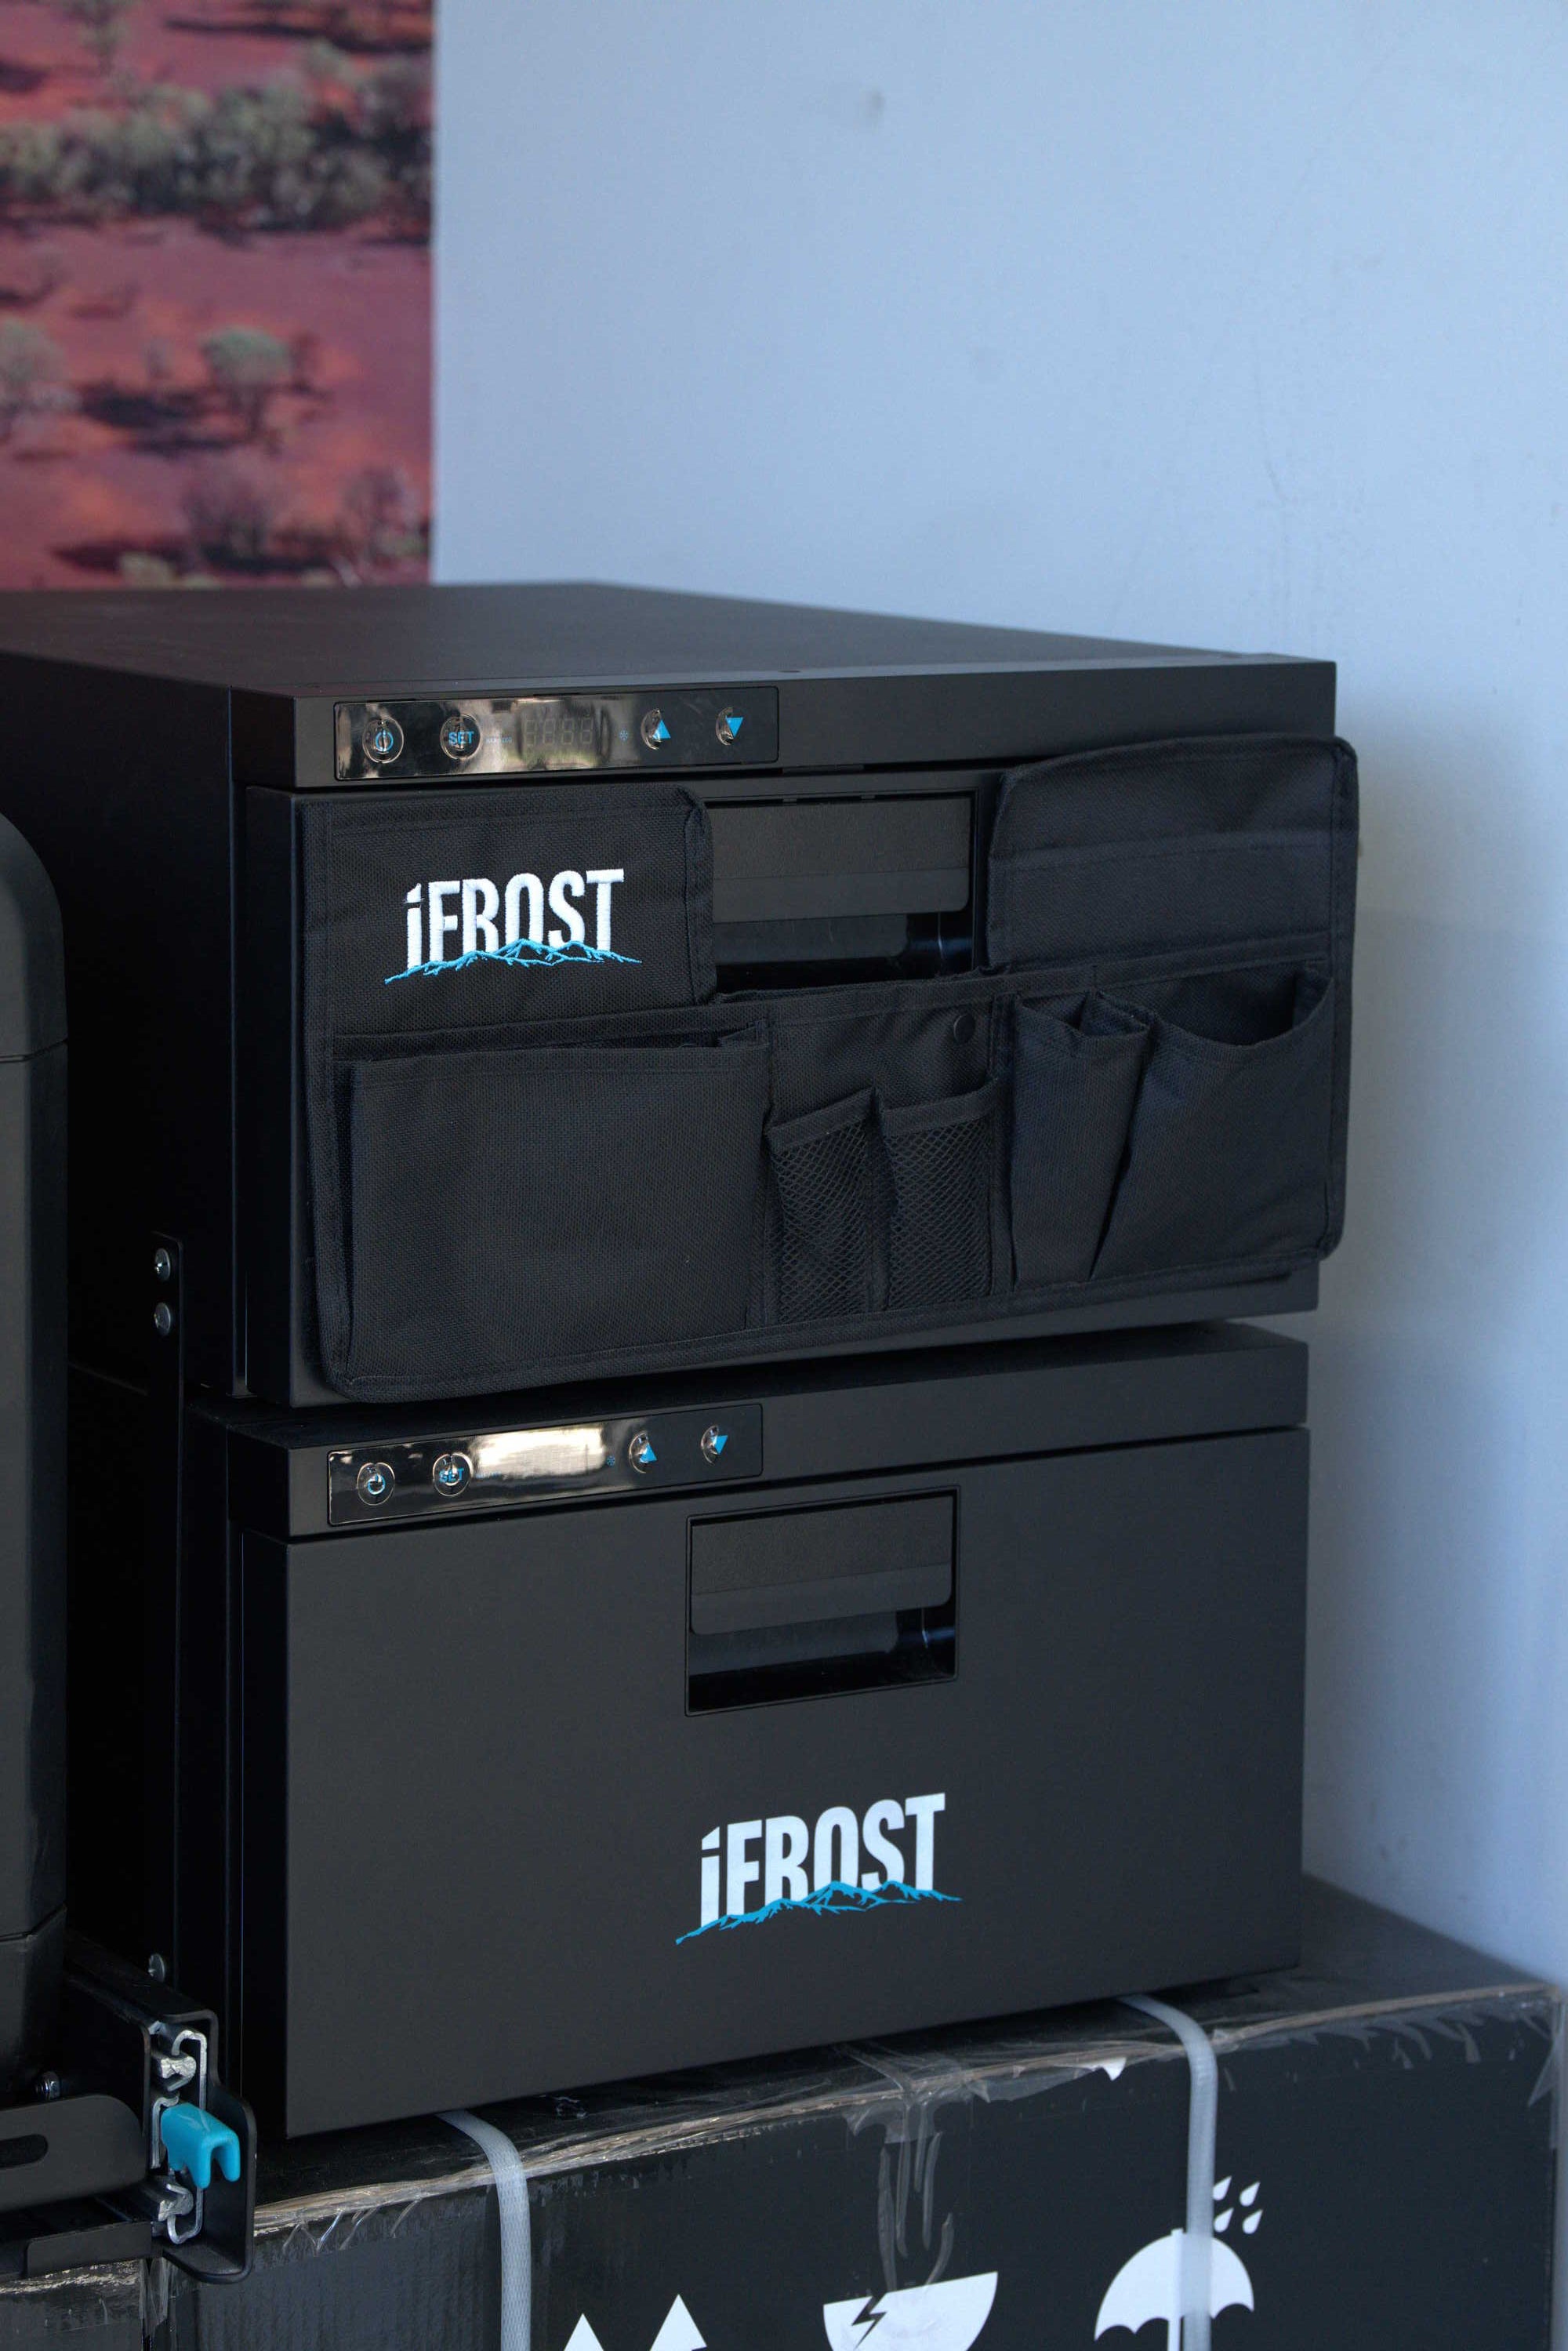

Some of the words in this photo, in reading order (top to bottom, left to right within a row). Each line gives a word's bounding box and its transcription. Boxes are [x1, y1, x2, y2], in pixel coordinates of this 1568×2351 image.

[448, 731, 474, 745] SET
[406, 868, 625, 969] iFROST
[438, 1467, 464, 1484] SET
[700, 1792, 946, 1928] iFROST
